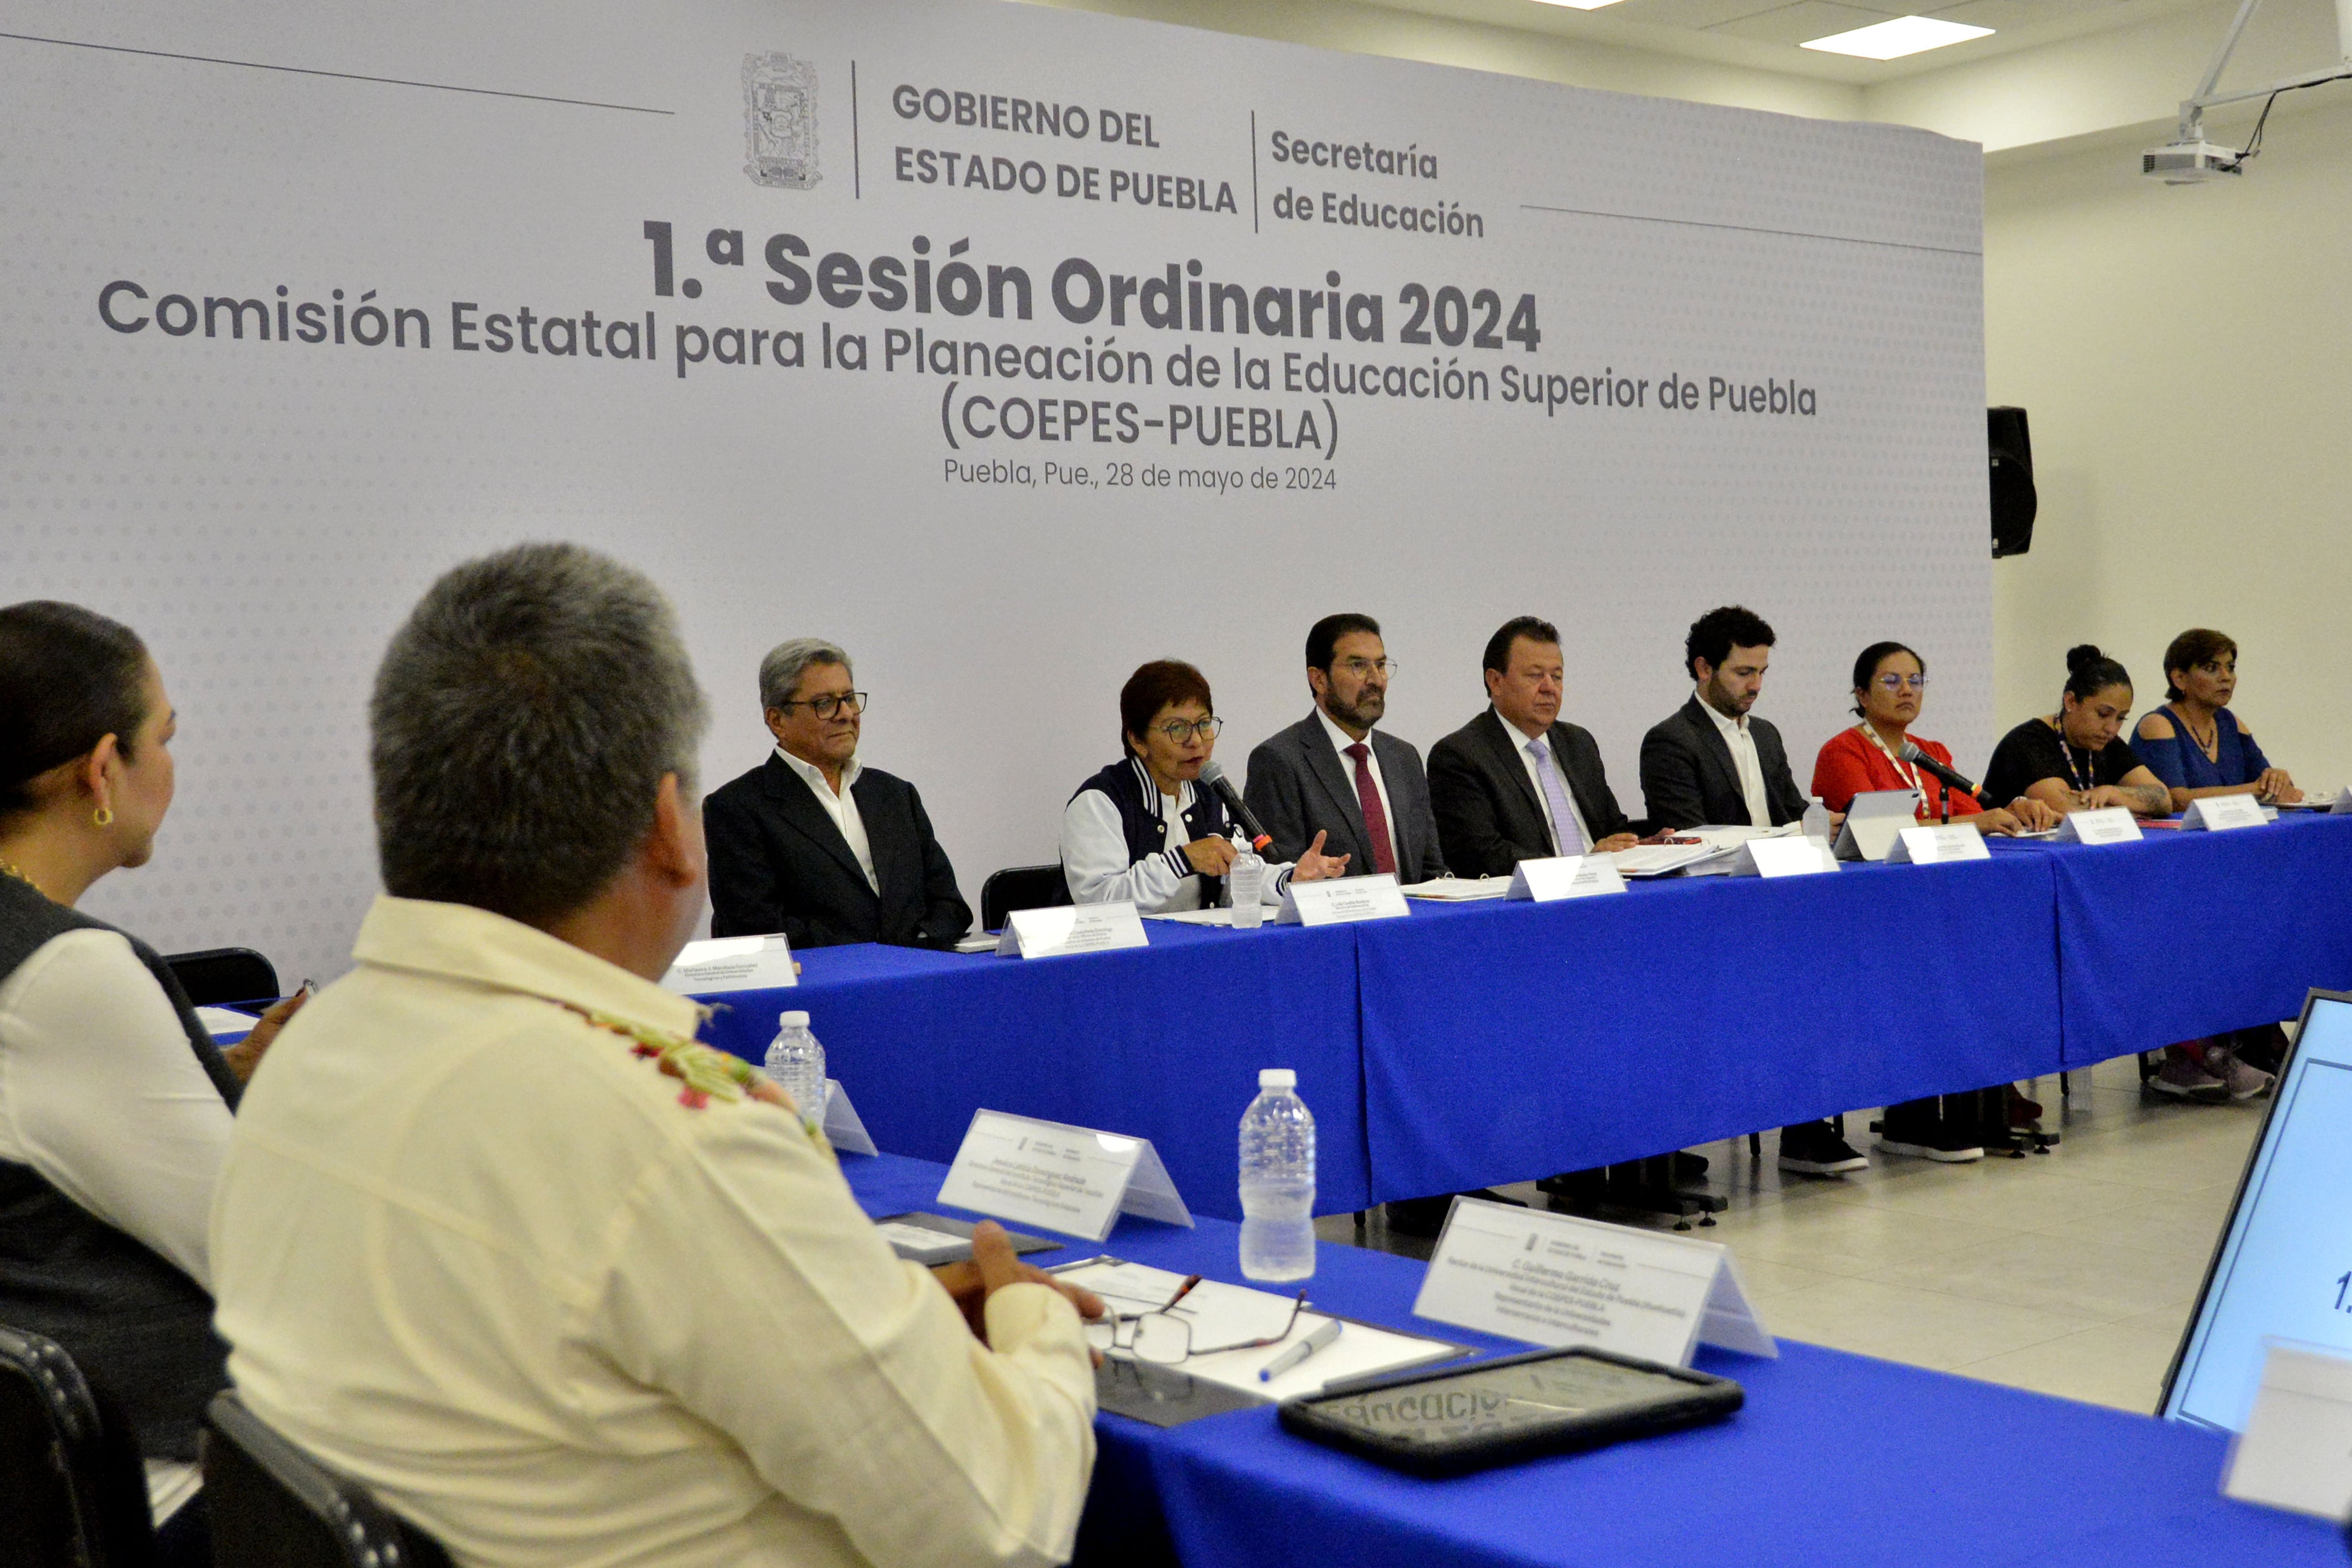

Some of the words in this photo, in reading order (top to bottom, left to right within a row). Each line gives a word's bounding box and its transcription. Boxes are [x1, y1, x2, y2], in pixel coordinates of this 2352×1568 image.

[892, 84, 1090, 140] GOBIERNO
[1099, 109, 1160, 149] DEL
[895, 145, 1047, 195] ESTADO
[1056, 163, 1101, 201] DE
[1109, 169, 1238, 215] PUEBLA
[1271, 130, 1438, 180] Secretaría
[1272, 186, 1314, 222] de
[1321, 191, 1484, 239] Educación
[764, 232, 1033, 321] Sesión
[1050, 257, 1384, 343] Ordinaria
[1398, 282, 1542, 353] 2024
[97, 279, 431, 350] Comisión
[451, 301, 657, 361] Estatal
[675, 324, 805, 379] para
[822, 321, 868, 371] la
[884, 327, 1153, 385] Planeación
[1166, 343, 1221, 389] de
[1233, 346, 1271, 391] la
[1283, 351, 1489, 401] Educación
[1500, 364, 1649, 418] Superior
[1658, 372, 1700, 411] de
[1708, 375, 1817, 416] Puebla
[941, 381, 1338, 461] (COEPES-PUEBLA)
[944, 458, 1037, 488] Puebla,
[1044, 461, 1099, 490] Pue.,
[1105, 462, 1134, 487] 28
[1141, 463, 1171, 487] de
[1178, 469, 1244, 496] mayo
[1250, 466, 1279, 490] de
[1285, 466, 1337, 490] 2024
